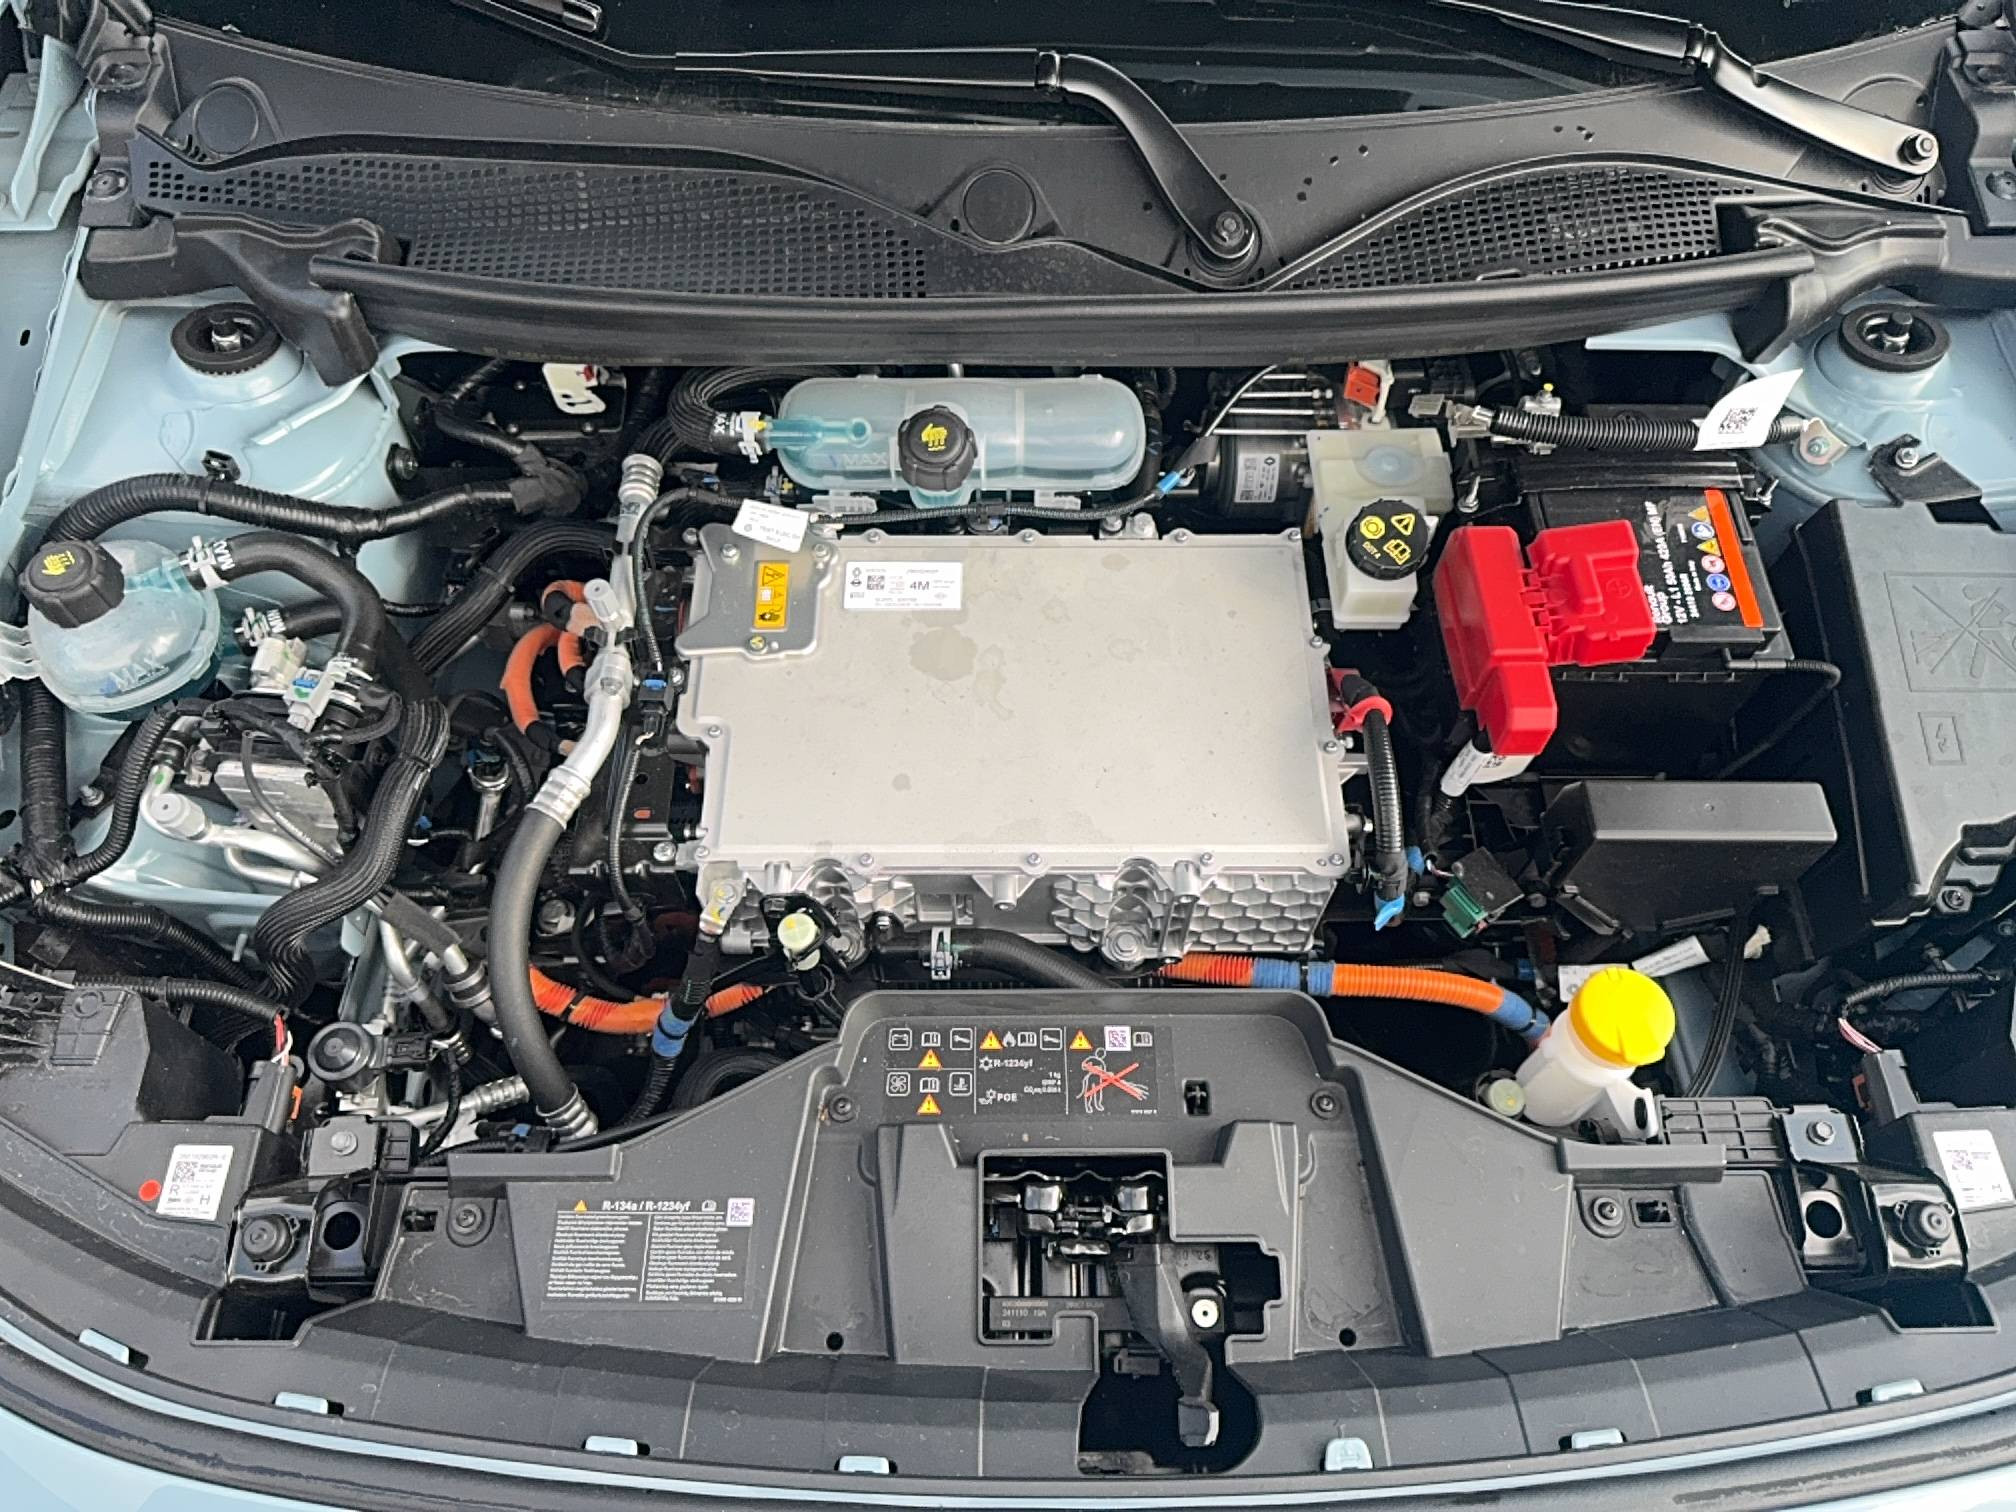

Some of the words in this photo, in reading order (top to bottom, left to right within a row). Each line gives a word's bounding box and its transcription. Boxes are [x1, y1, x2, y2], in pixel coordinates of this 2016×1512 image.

[842, 452, 888, 465] MAX
[909, 581, 930, 591] 4M
[993, 1058, 1033, 1069] R-1234yf
[997, 1093, 1017, 1102] POE
[200, 1194, 210, 1205] H
[602, 1201, 638, 1211] R-134a
[645, 1201, 691, 1212] R-1234yf
